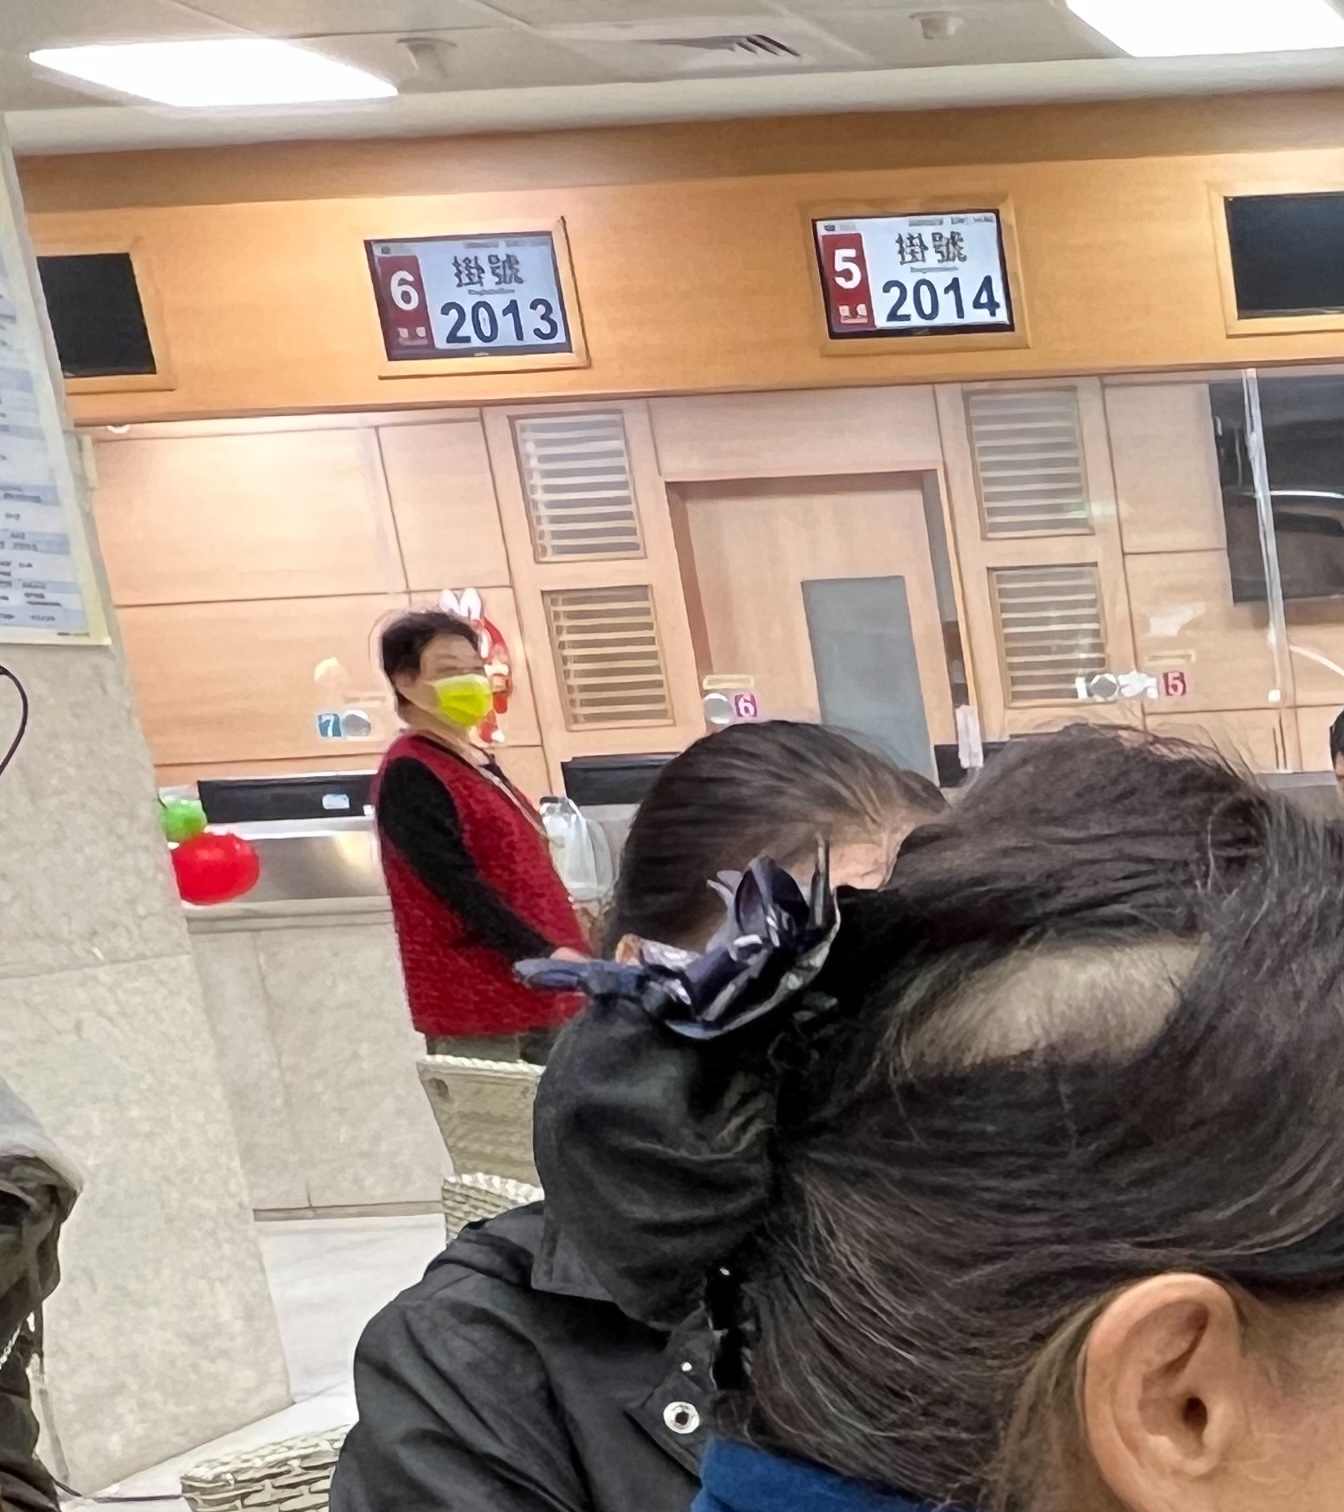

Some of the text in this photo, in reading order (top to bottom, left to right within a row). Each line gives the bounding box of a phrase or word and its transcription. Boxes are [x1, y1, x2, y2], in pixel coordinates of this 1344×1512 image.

[896, 231, 968, 266] 掛號
[451, 253, 525, 288] 掛號
[834, 249, 862, 290] 5
[390, 270, 420, 311] 6
[882, 275, 1001, 323] 2014
[440, 298, 559, 344] 2013
[737, 692, 756, 719] 6
[320, 714, 335, 737] 7
